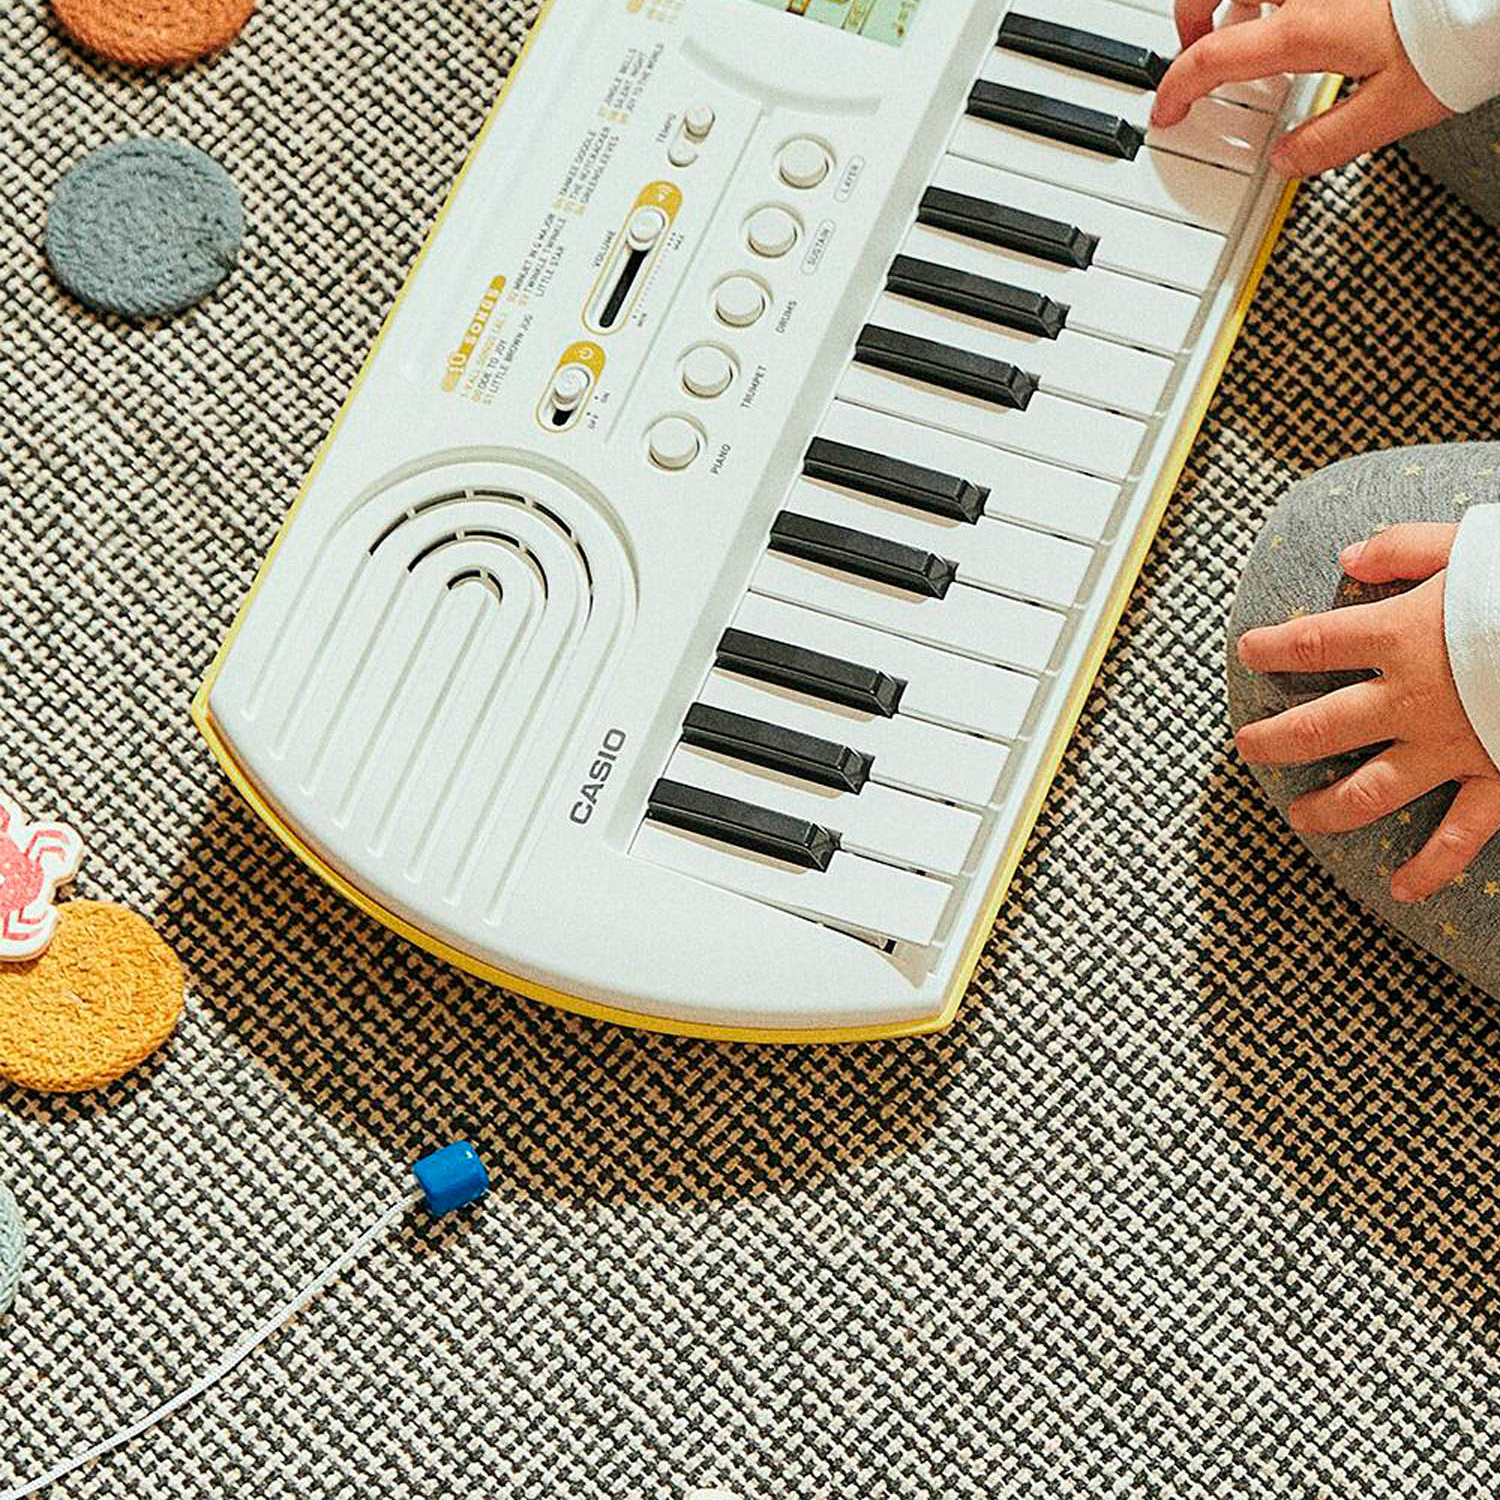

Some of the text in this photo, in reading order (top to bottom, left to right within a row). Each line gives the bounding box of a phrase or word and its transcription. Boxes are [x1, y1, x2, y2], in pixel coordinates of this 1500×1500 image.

[655, 112, 677, 143] TEMPO
[568, 182, 583, 200] THE
[839, 163, 861, 193] LAYER
[536, 212, 556, 241] MAJOR
[523, 256, 546, 292] TWINKLE
[542, 217, 566, 254] TWINKLE
[591, 229, 616, 267] VOLUME
[805, 226, 831, 266] SUSTAIN
[534, 245, 566, 297] LITTLE STAR
[774, 299, 798, 333] DRUMS
[486, 356, 499, 368] TO
[493, 339, 508, 354] JOY
[488, 364, 509, 393] LITTLE
[503, 331, 525, 362] BROWN
[519, 313, 534, 330] JUG
[738, 364, 769, 410] TRUMPET
[709, 443, 732, 474] PIANO
[568, 728, 626, 826] CASIO
